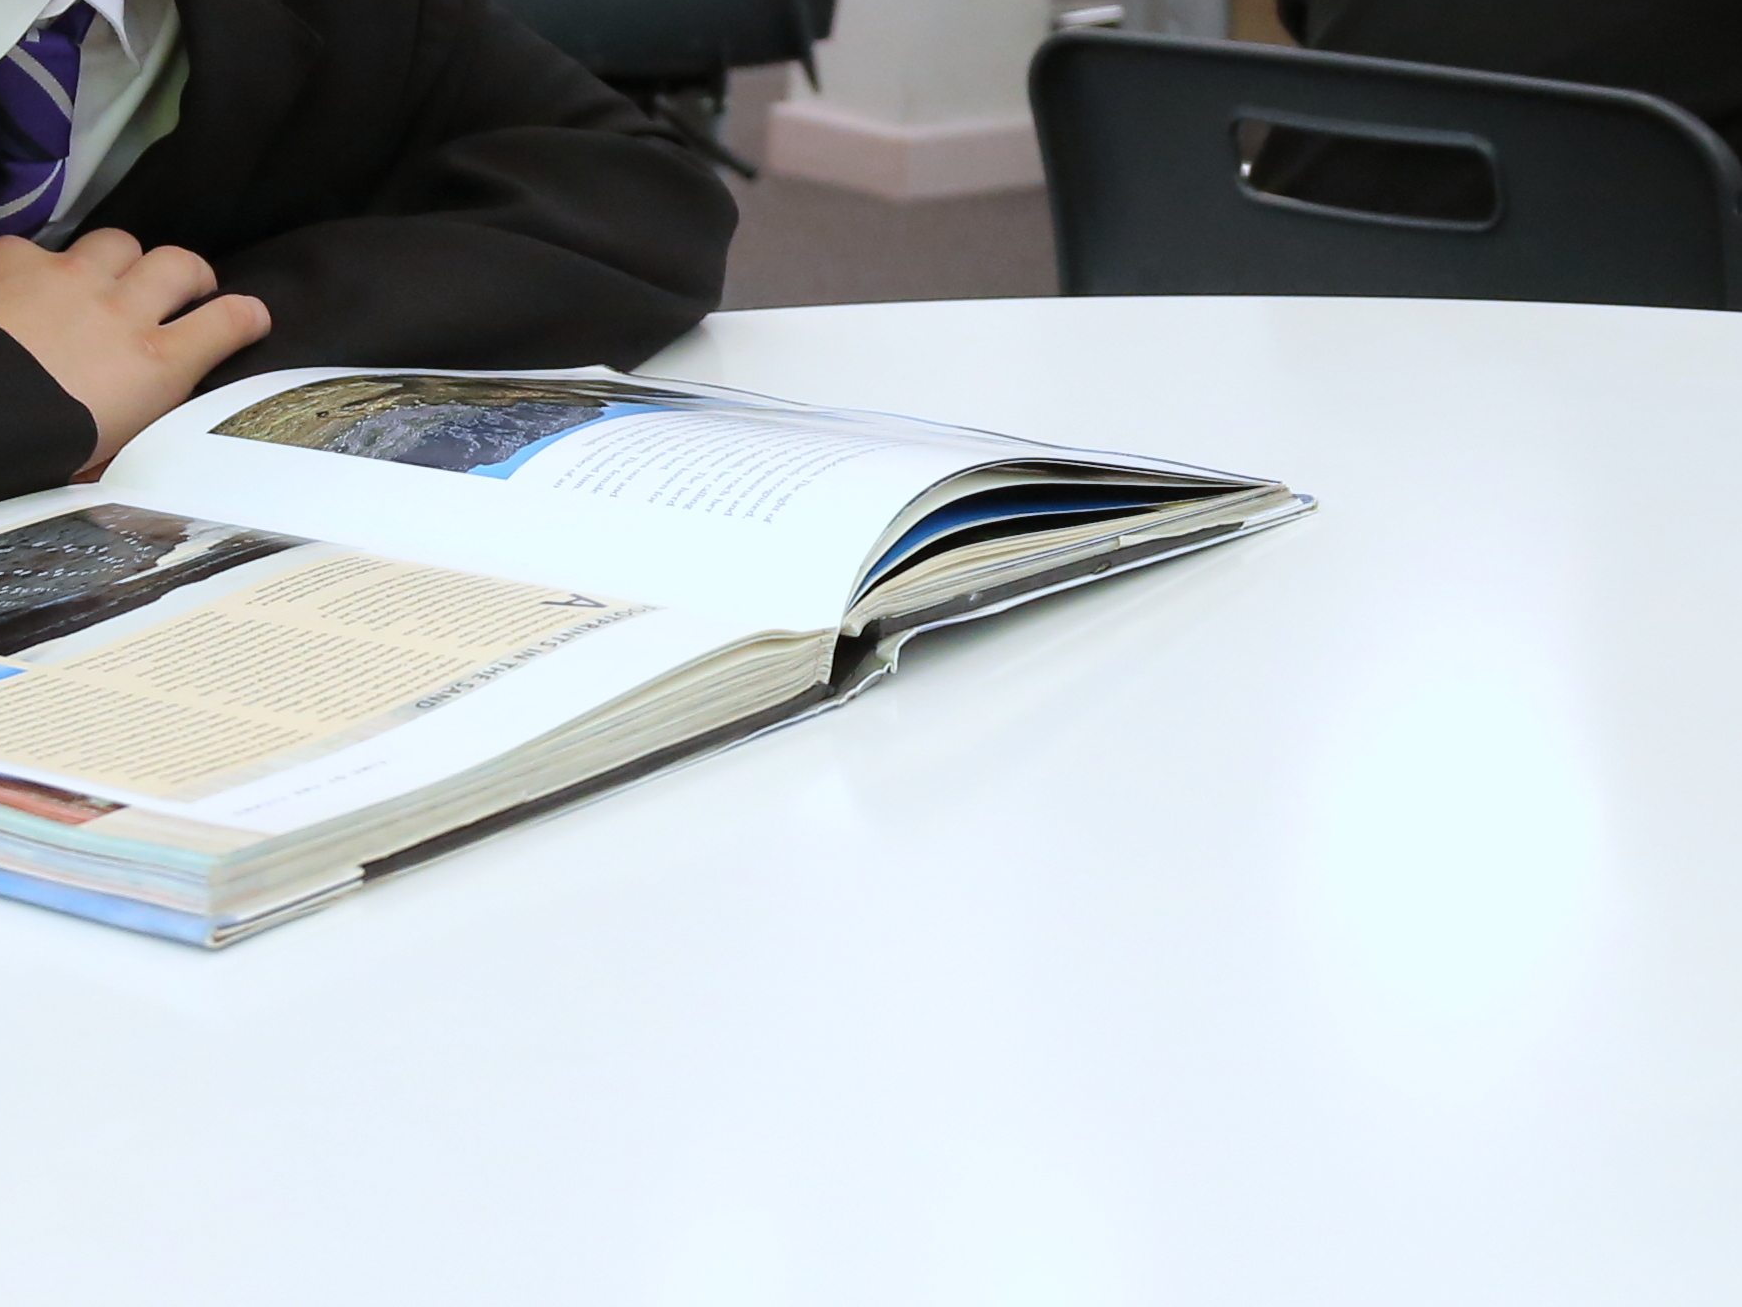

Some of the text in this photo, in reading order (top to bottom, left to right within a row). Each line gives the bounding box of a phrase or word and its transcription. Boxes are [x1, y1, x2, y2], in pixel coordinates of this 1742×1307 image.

[513, 648, 542, 661] IN
[471, 661, 518, 681] THE
[415, 681, 476, 710] SAND
